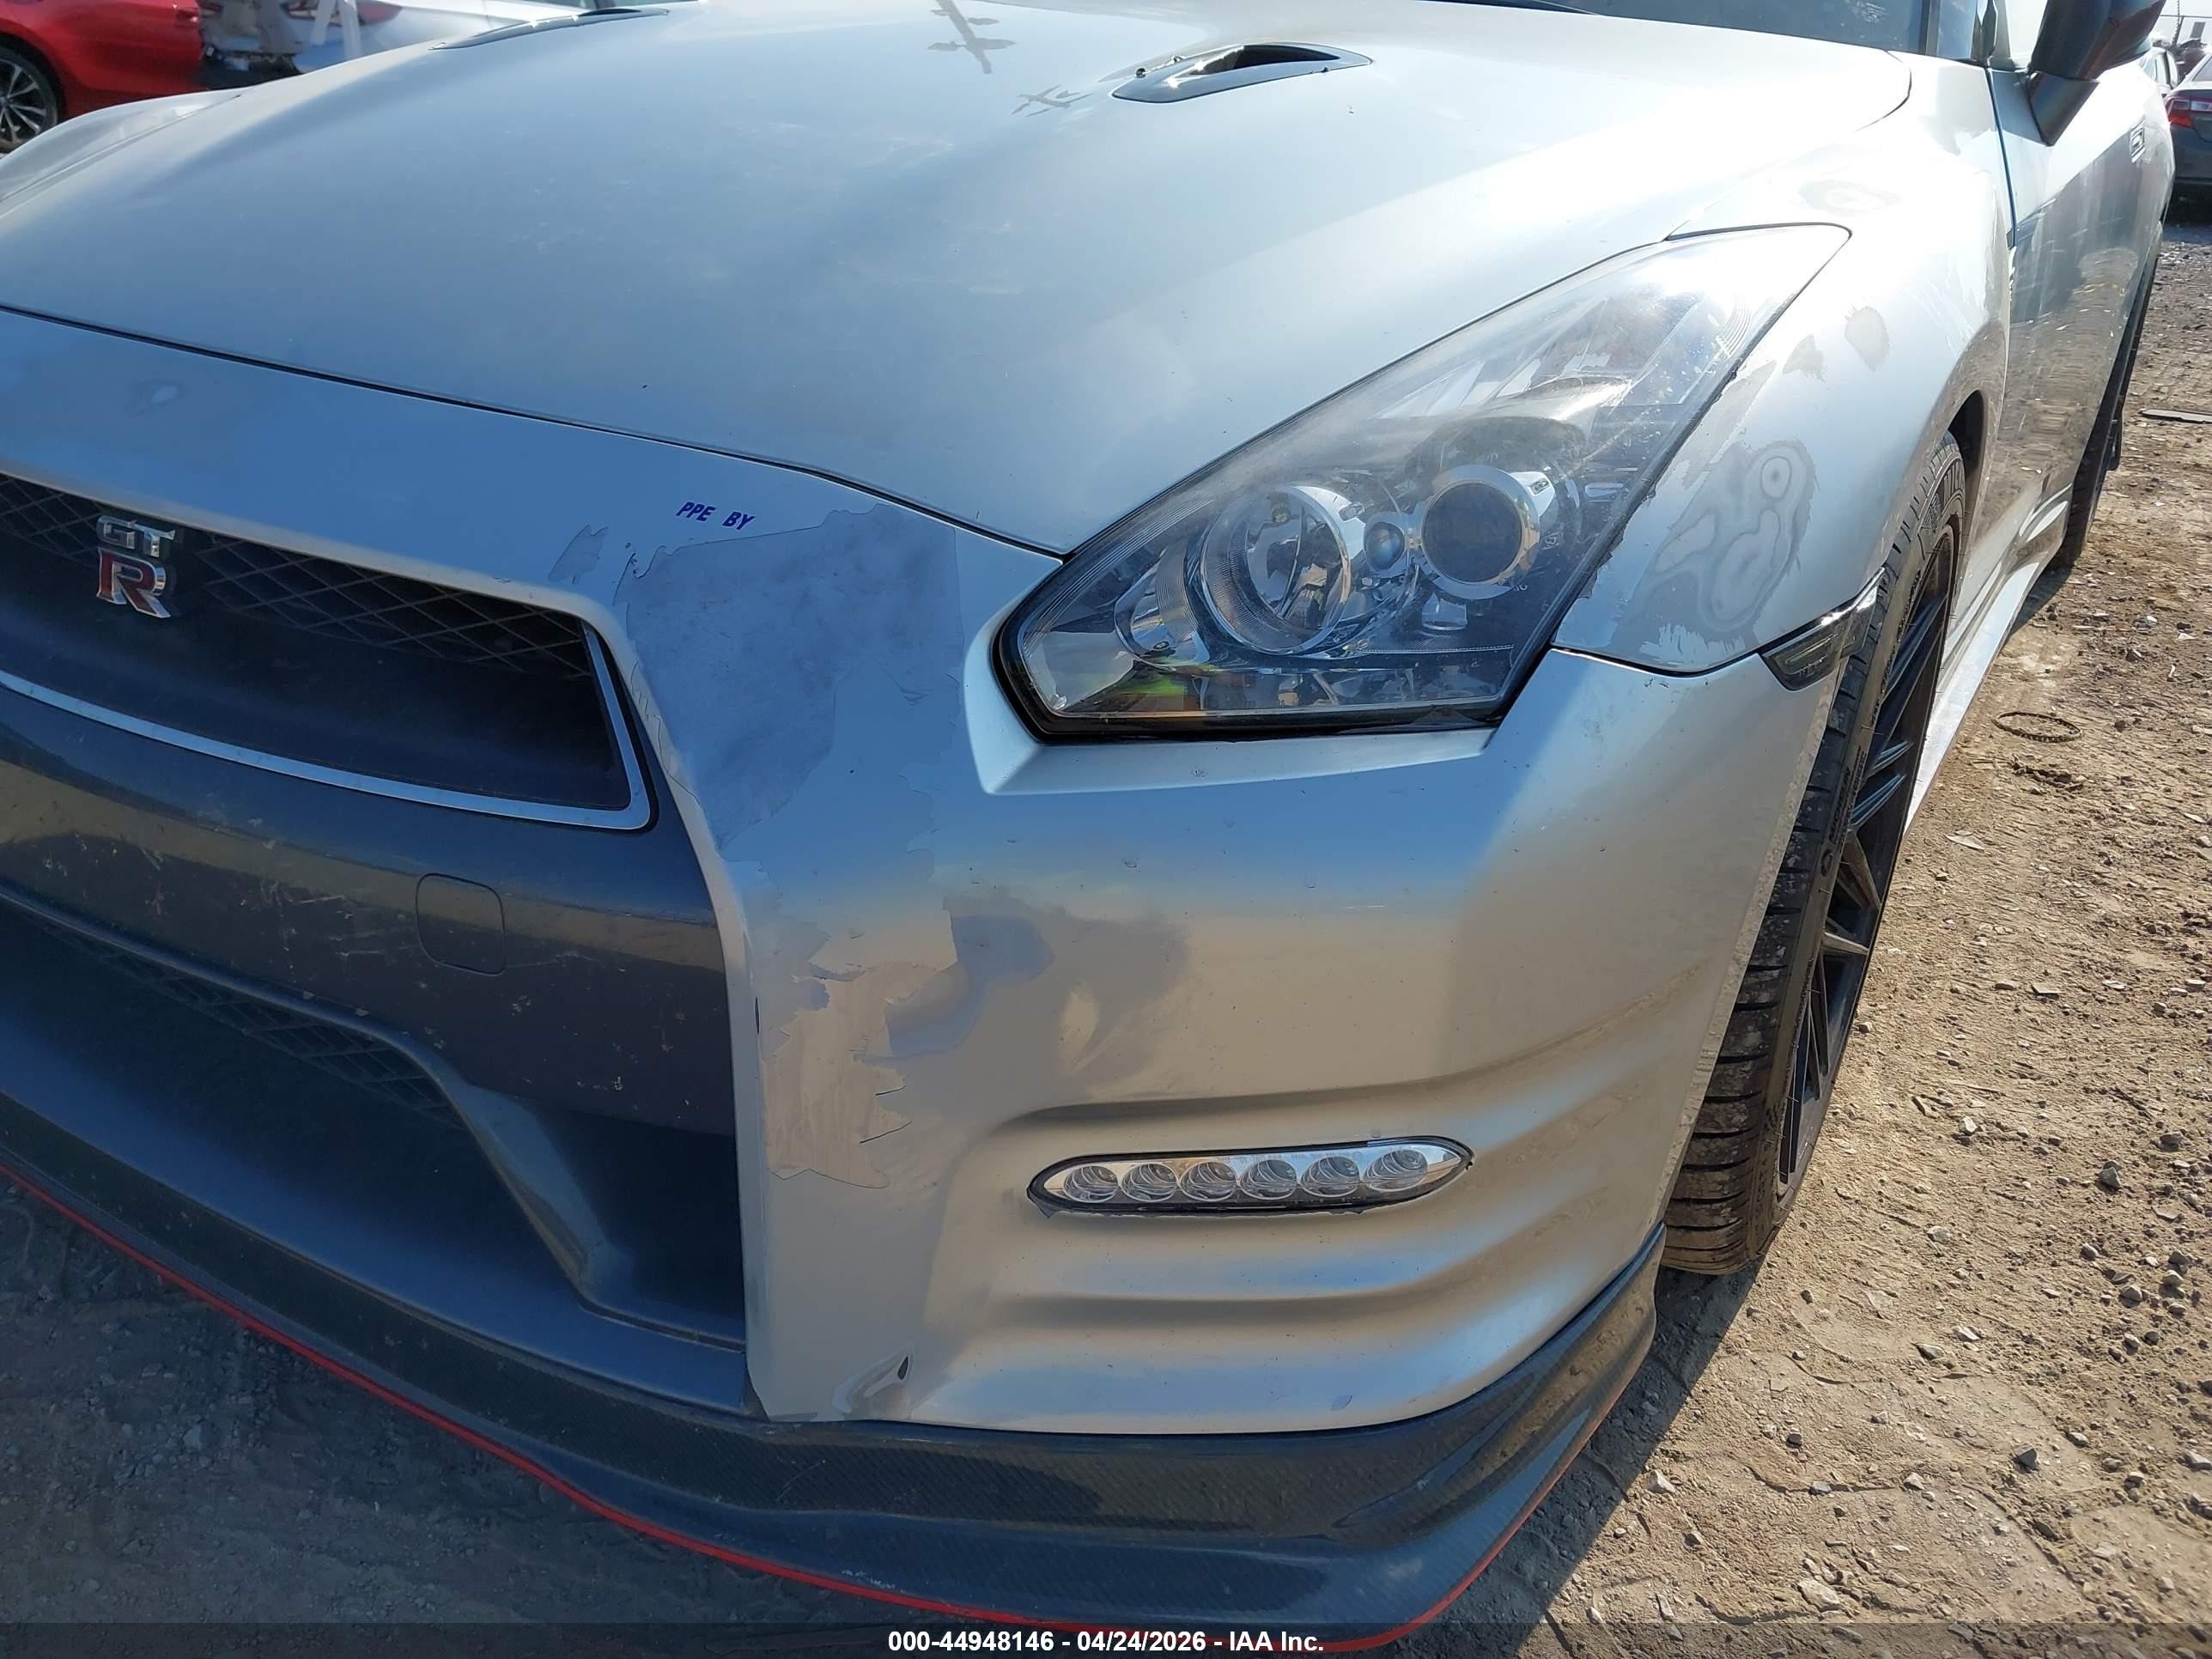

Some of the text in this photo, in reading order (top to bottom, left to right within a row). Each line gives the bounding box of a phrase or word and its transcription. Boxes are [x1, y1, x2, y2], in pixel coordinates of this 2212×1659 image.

[675, 501, 756, 531] PPE BY
[95, 546, 172, 619] R
